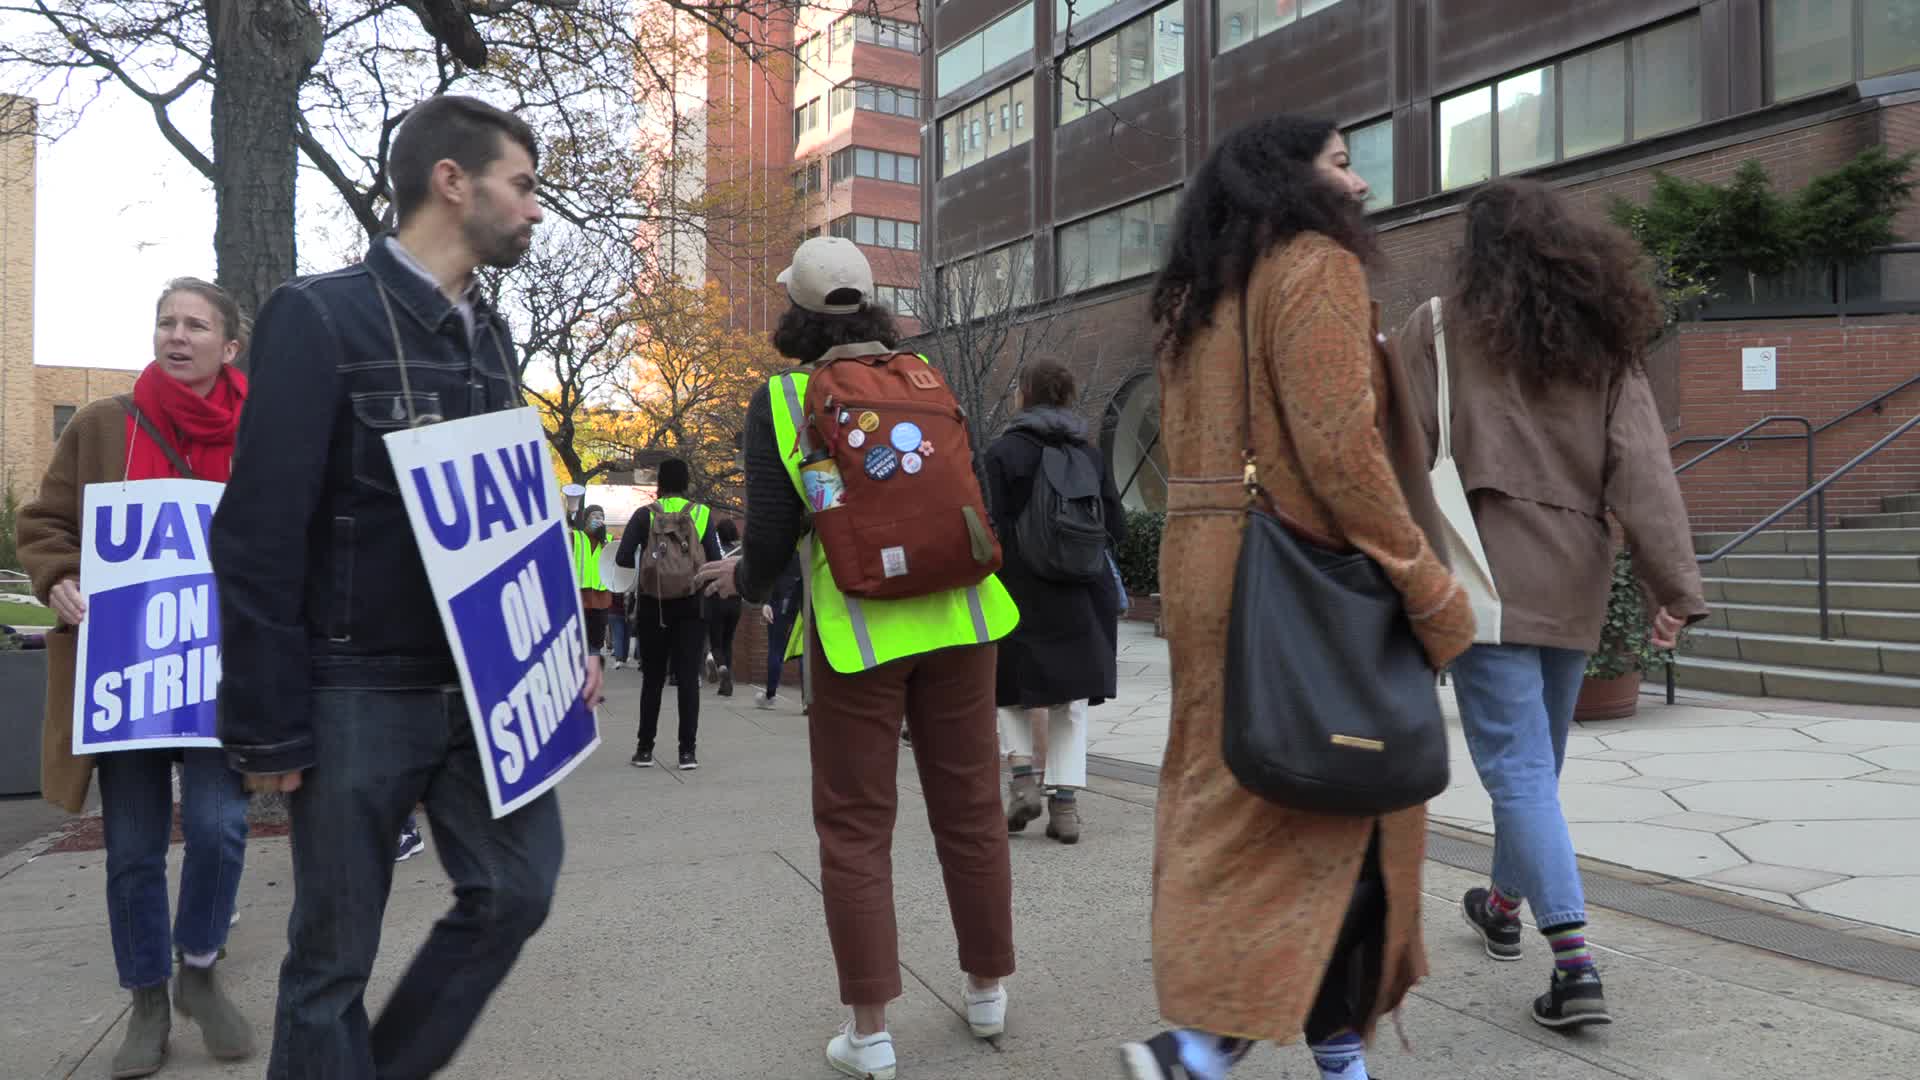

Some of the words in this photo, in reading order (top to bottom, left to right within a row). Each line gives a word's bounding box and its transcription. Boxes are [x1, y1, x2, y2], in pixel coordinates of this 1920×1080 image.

[410, 440, 548, 551] UAW
[145, 584, 209, 650] ON
[501, 560, 551, 662] ON
[489, 614, 587, 784] STRIKE
